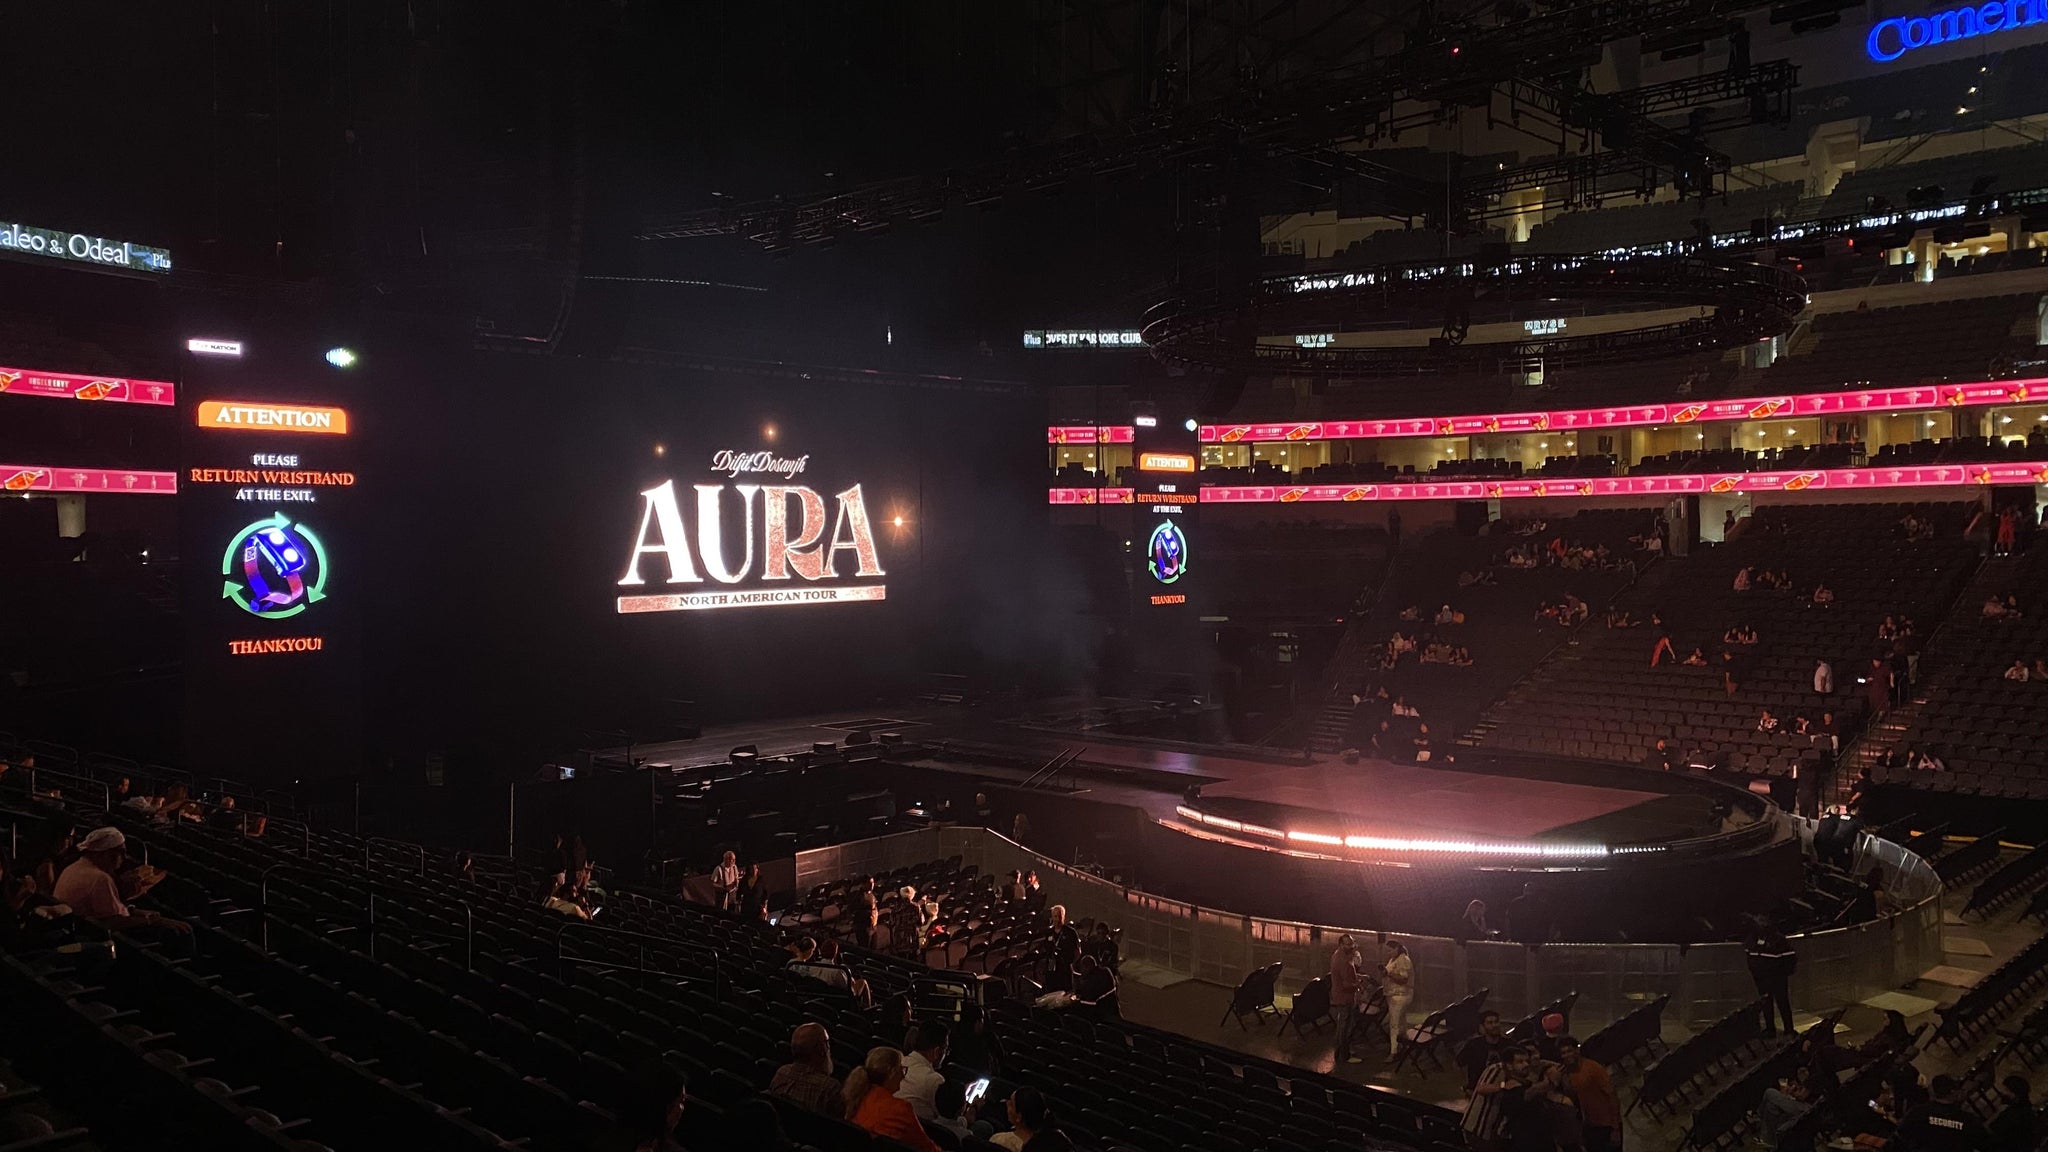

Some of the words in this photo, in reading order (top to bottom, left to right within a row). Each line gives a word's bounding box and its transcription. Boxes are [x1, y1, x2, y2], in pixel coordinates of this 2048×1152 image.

[1867, 0, 2048, 62] Comeri
[0, 224, 45, 251] aleo
[50, 239, 63, 254] &
[68, 234, 130, 264] Odeal
[1120, 333, 1142, 344] CLUB
[216, 406, 331, 428] ATTENTION
[253, 454, 298, 467] PLEASE
[711, 450, 755, 478] Diljit
[751, 451, 809, 480] Dosanjh
[1145, 457, 1189, 469] ATTENTION
[190, 468, 259, 484] RETURN
[260, 471, 355, 486] WRISTBAND
[235, 489, 253, 501] AT
[255, 489, 281, 501] THE
[283, 490, 316, 503] EXIT.
[1137, 493, 1162, 503] RETURN
[1162, 494, 1198, 504] WRISTBAND
[617, 479, 886, 585] AURA
[679, 594, 728, 607] NORTH
[731, 591, 803, 606] AMERICAN
[804, 590, 837, 602] TOUR
[229, 638, 322, 655] THANKYOU!
[1929, 1117, 1963, 1130] SECURITY
